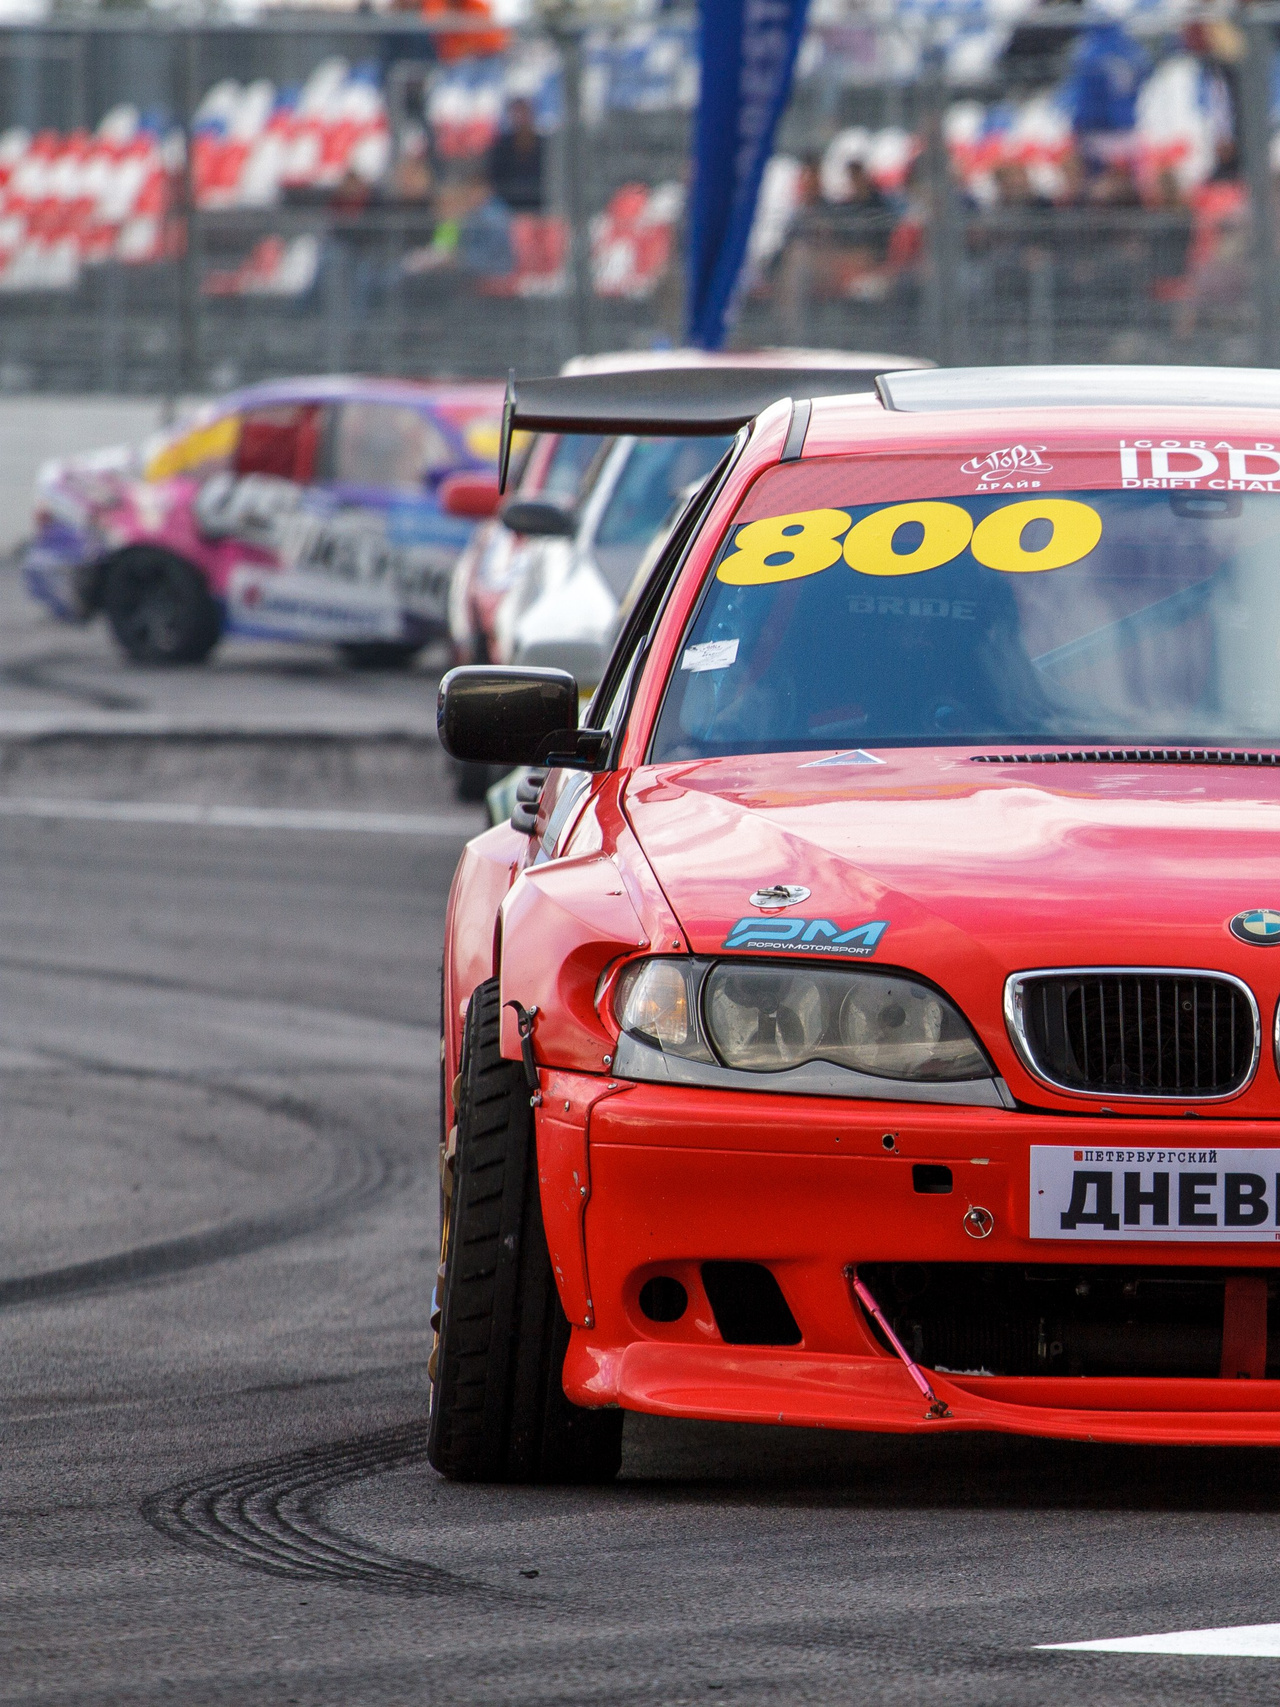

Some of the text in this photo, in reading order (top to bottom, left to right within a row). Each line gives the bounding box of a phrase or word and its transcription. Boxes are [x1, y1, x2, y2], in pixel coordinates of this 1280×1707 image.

[1120, 440, 1234, 450] IGORA
[975, 480, 1041, 491] ДРАЙВ
[1122, 478, 1201, 489] DRIFT
[716, 498, 1102, 586] 800
[846, 595, 977, 620] BRIDE
[725, 918, 887, 947] PM
[747, 941, 872, 954] POPOVMOTORSPORT
[1084, 1150, 1218, 1163] ПЕТЕРБУРГСКИЙ
